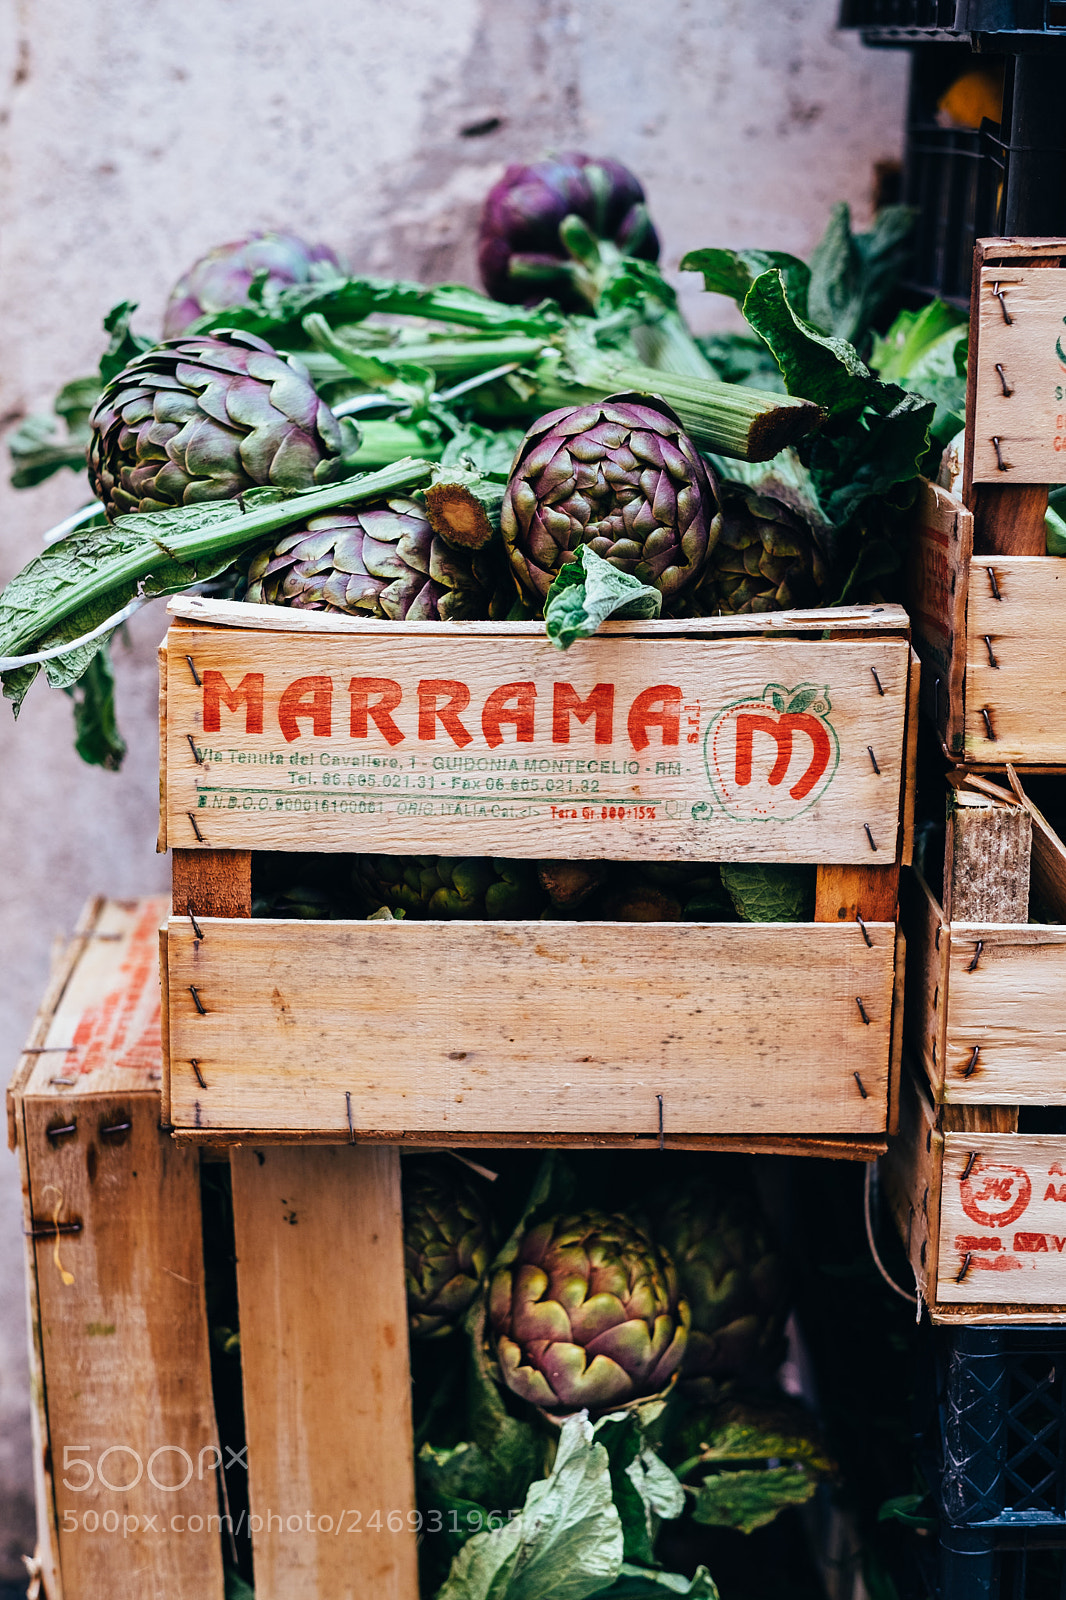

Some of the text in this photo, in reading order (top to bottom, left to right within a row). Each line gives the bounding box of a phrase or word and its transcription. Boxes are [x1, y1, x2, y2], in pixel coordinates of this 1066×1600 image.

[202, 670, 684, 752] MARRAMA
[196, 747, 223, 762] Via
[227, 749, 284, 765] Tenuta
[289, 752, 314, 766] del
[432, 756, 520, 771] GUIDONIA
[523, 758, 640, 775] MONTECELIO
[655, 761, 682, 775] RM
[287, 771, 317, 785] Tel.
[451, 776, 480, 790] Fax
[441, 803, 487, 818] ITALIA
